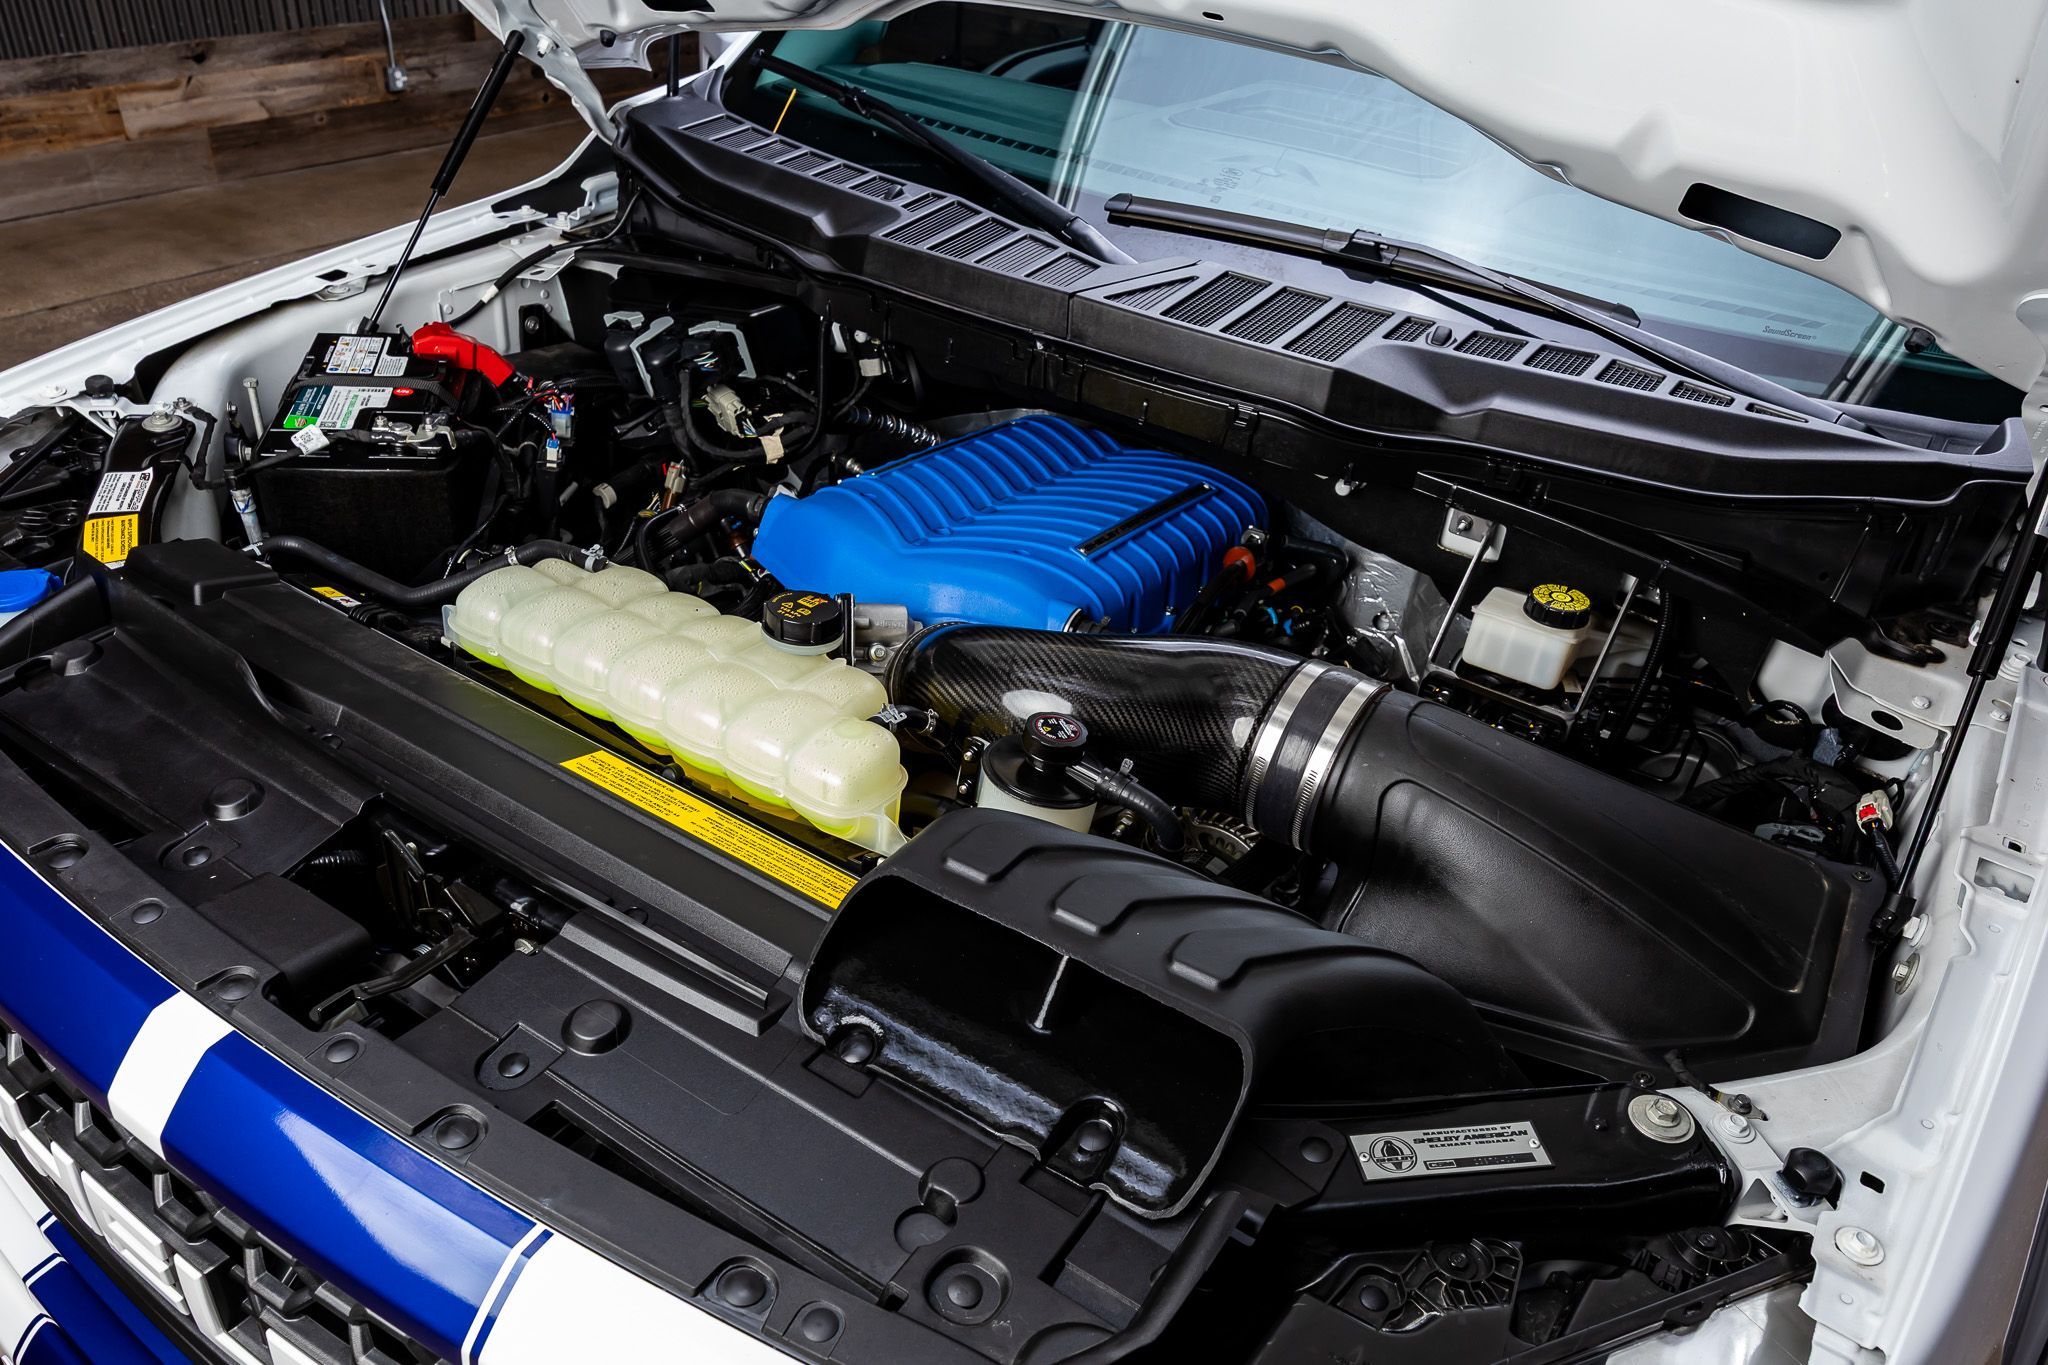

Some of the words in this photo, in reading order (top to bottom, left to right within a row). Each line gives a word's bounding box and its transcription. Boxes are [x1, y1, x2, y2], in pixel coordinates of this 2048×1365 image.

[1422, 1126, 1499, 1136] MANUFACTURED
[1412, 1135, 1460, 1145] SHELBY
[1463, 1129, 1529, 1141] AMERICAN
[1475, 1138, 1516, 1146] INDIANA
[1376, 1155, 1415, 1164] SHELBY
